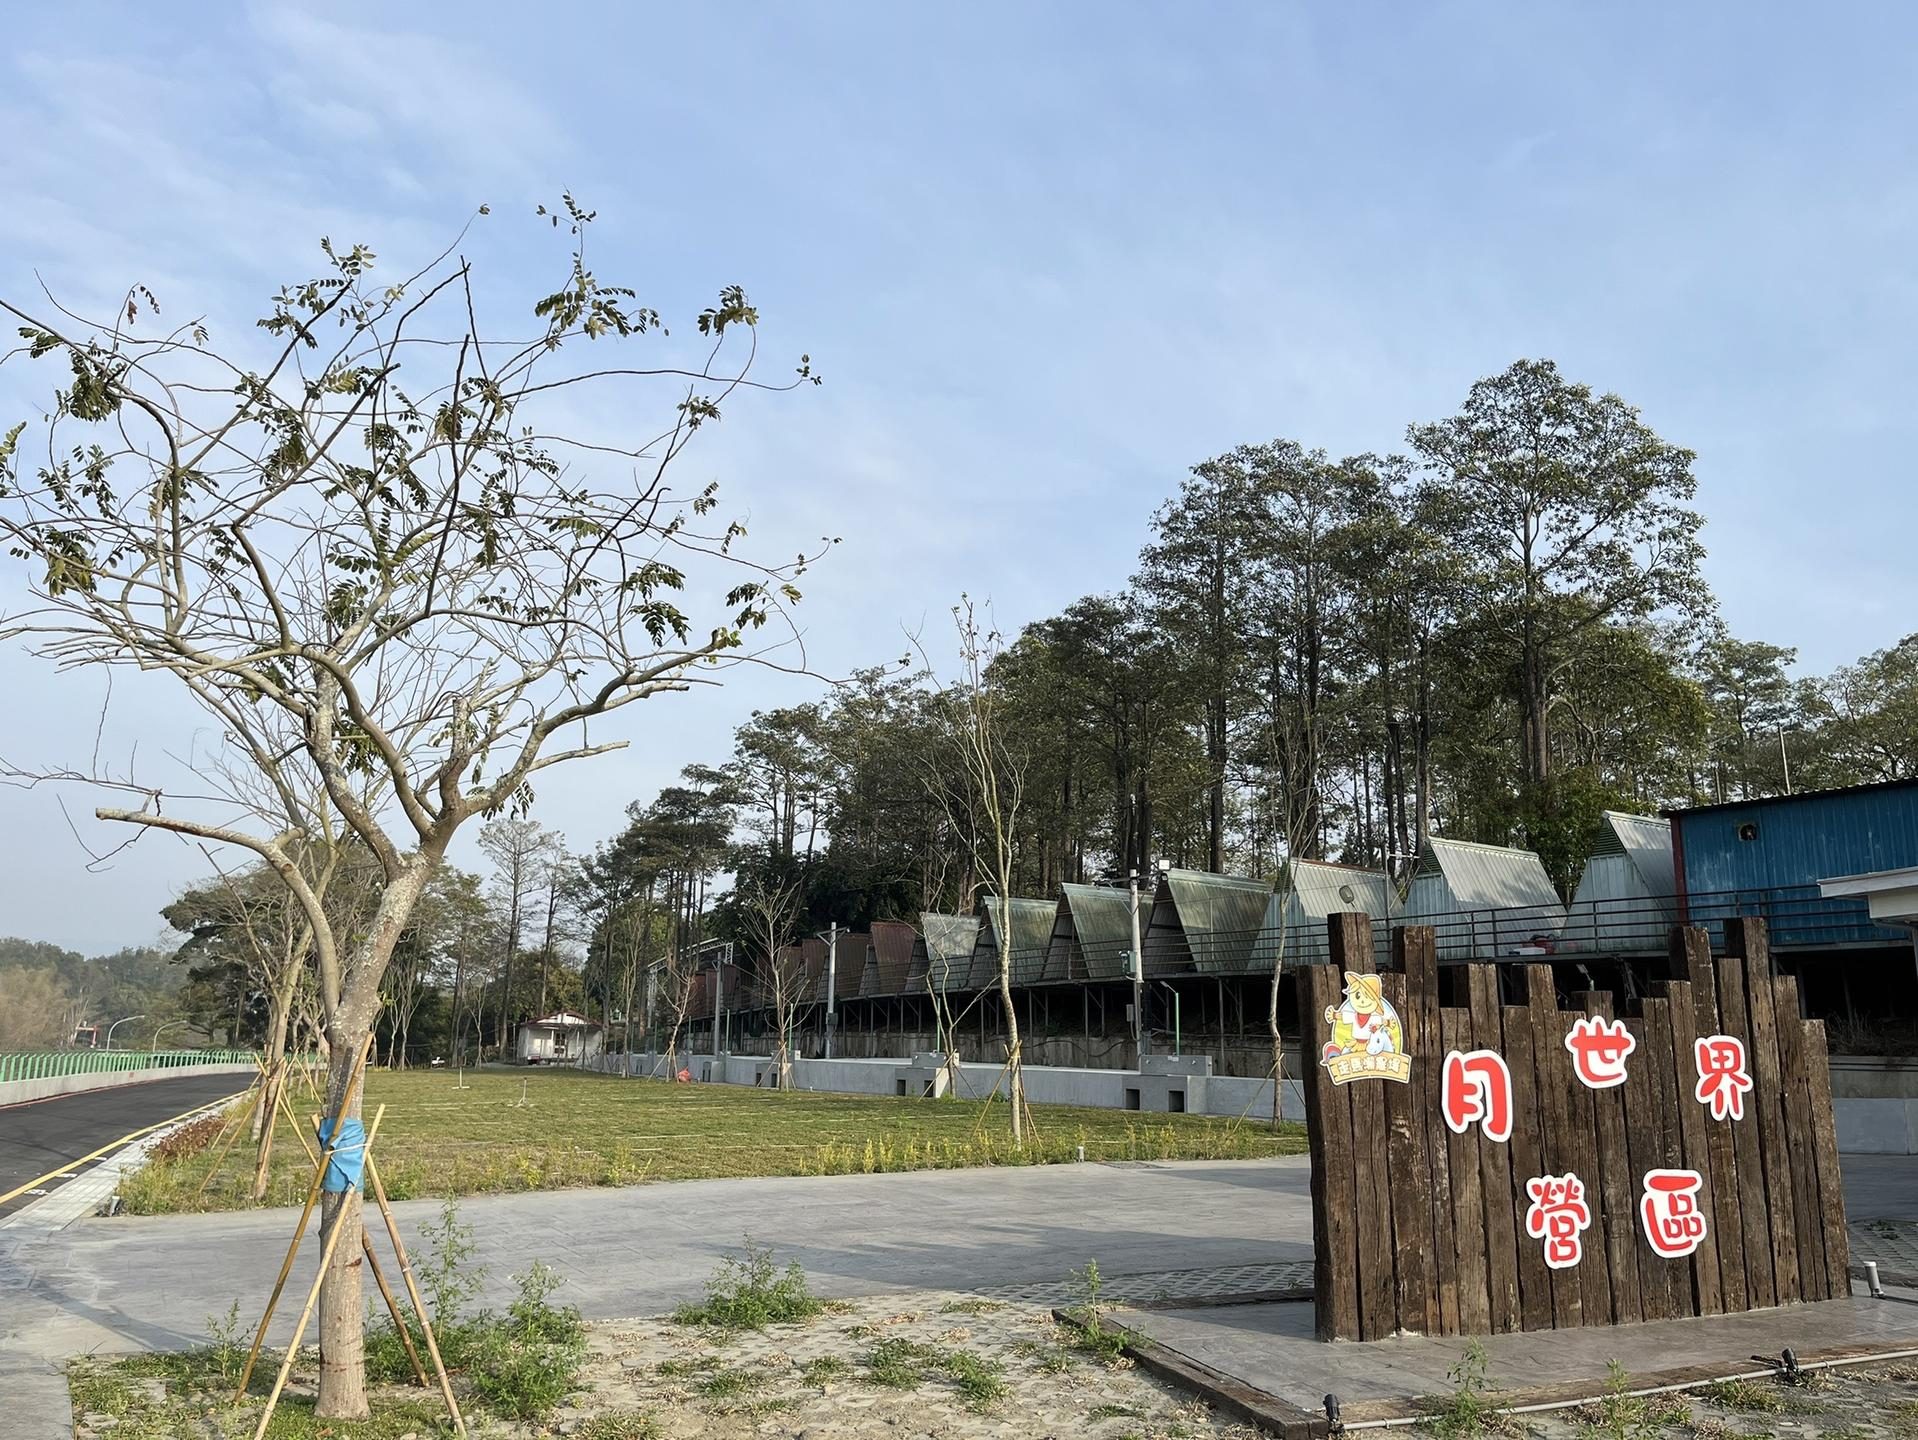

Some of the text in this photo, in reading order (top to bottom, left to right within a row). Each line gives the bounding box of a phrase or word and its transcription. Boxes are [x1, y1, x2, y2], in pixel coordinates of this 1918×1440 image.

[1446, 1022, 1750, 1137] 月世界
[1530, 1173, 1704, 1264] 營區
